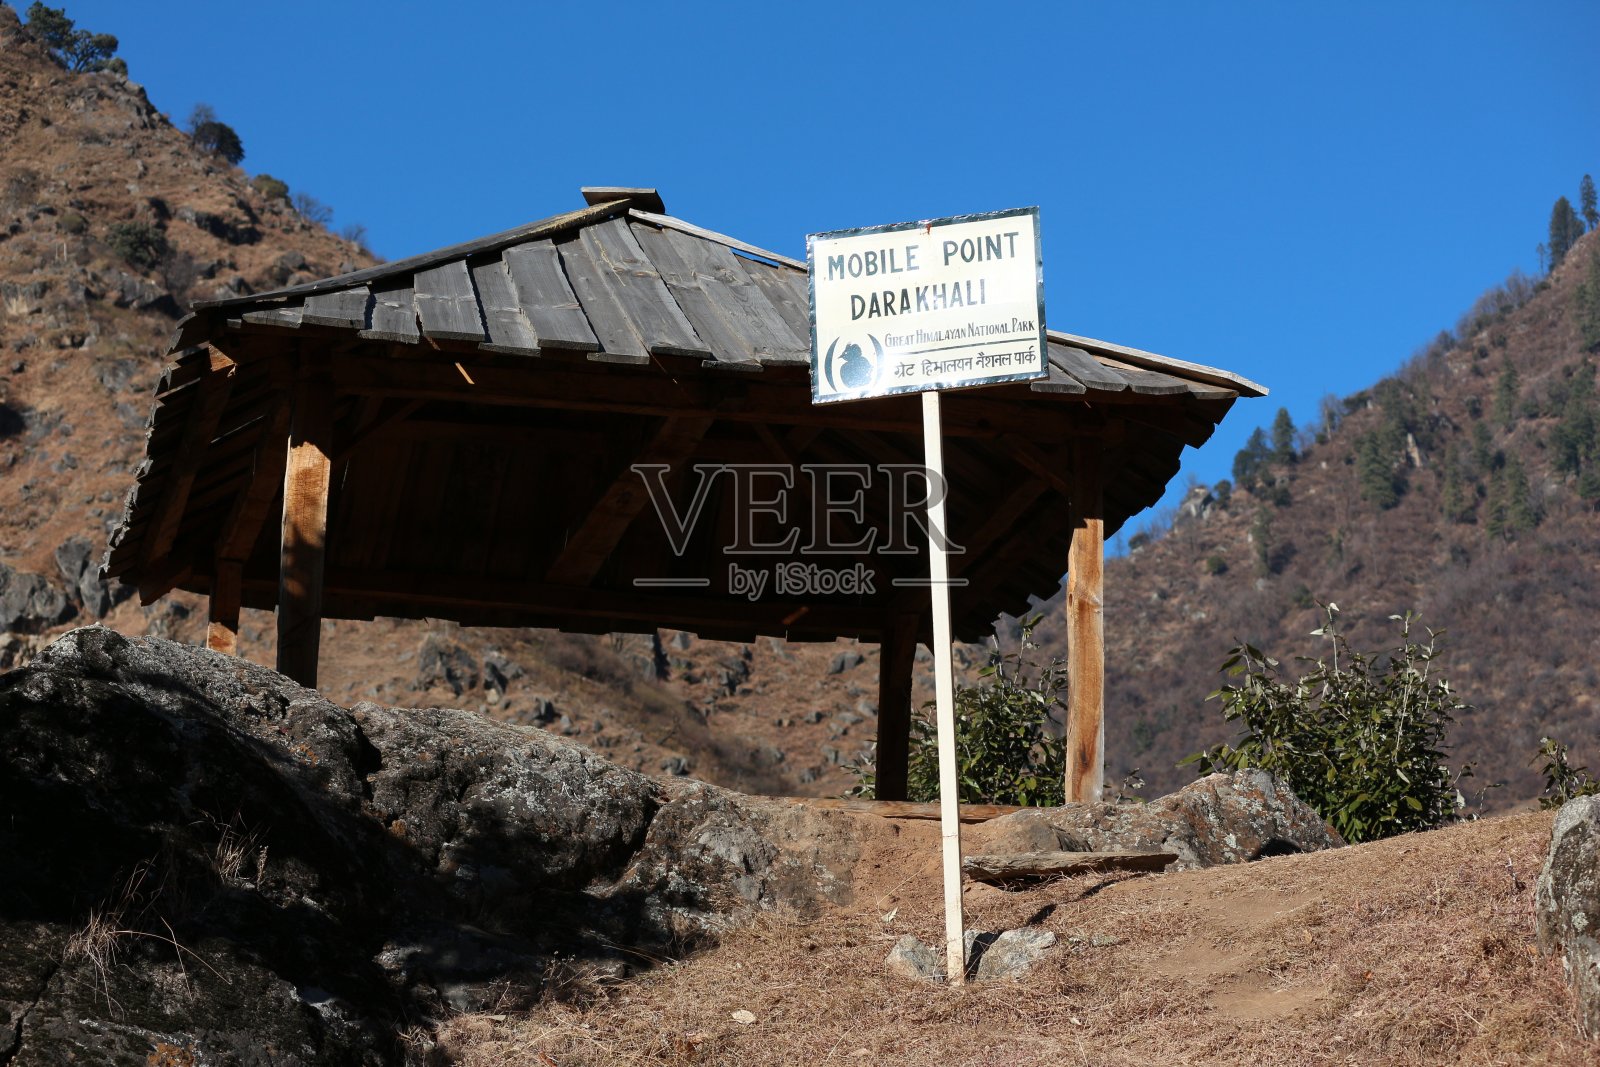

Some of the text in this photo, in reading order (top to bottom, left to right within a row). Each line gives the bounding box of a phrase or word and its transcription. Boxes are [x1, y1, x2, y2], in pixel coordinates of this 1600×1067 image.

[828, 232, 1019, 281] MOBILE POINT
[851, 279, 986, 321] DARAKHALI
[885, 318, 1035, 348] GREAT HIMALAYAN NATIONAL PARK
[894, 345, 1036, 378] ग्रेट हिमालयन नैशनल पार्क
